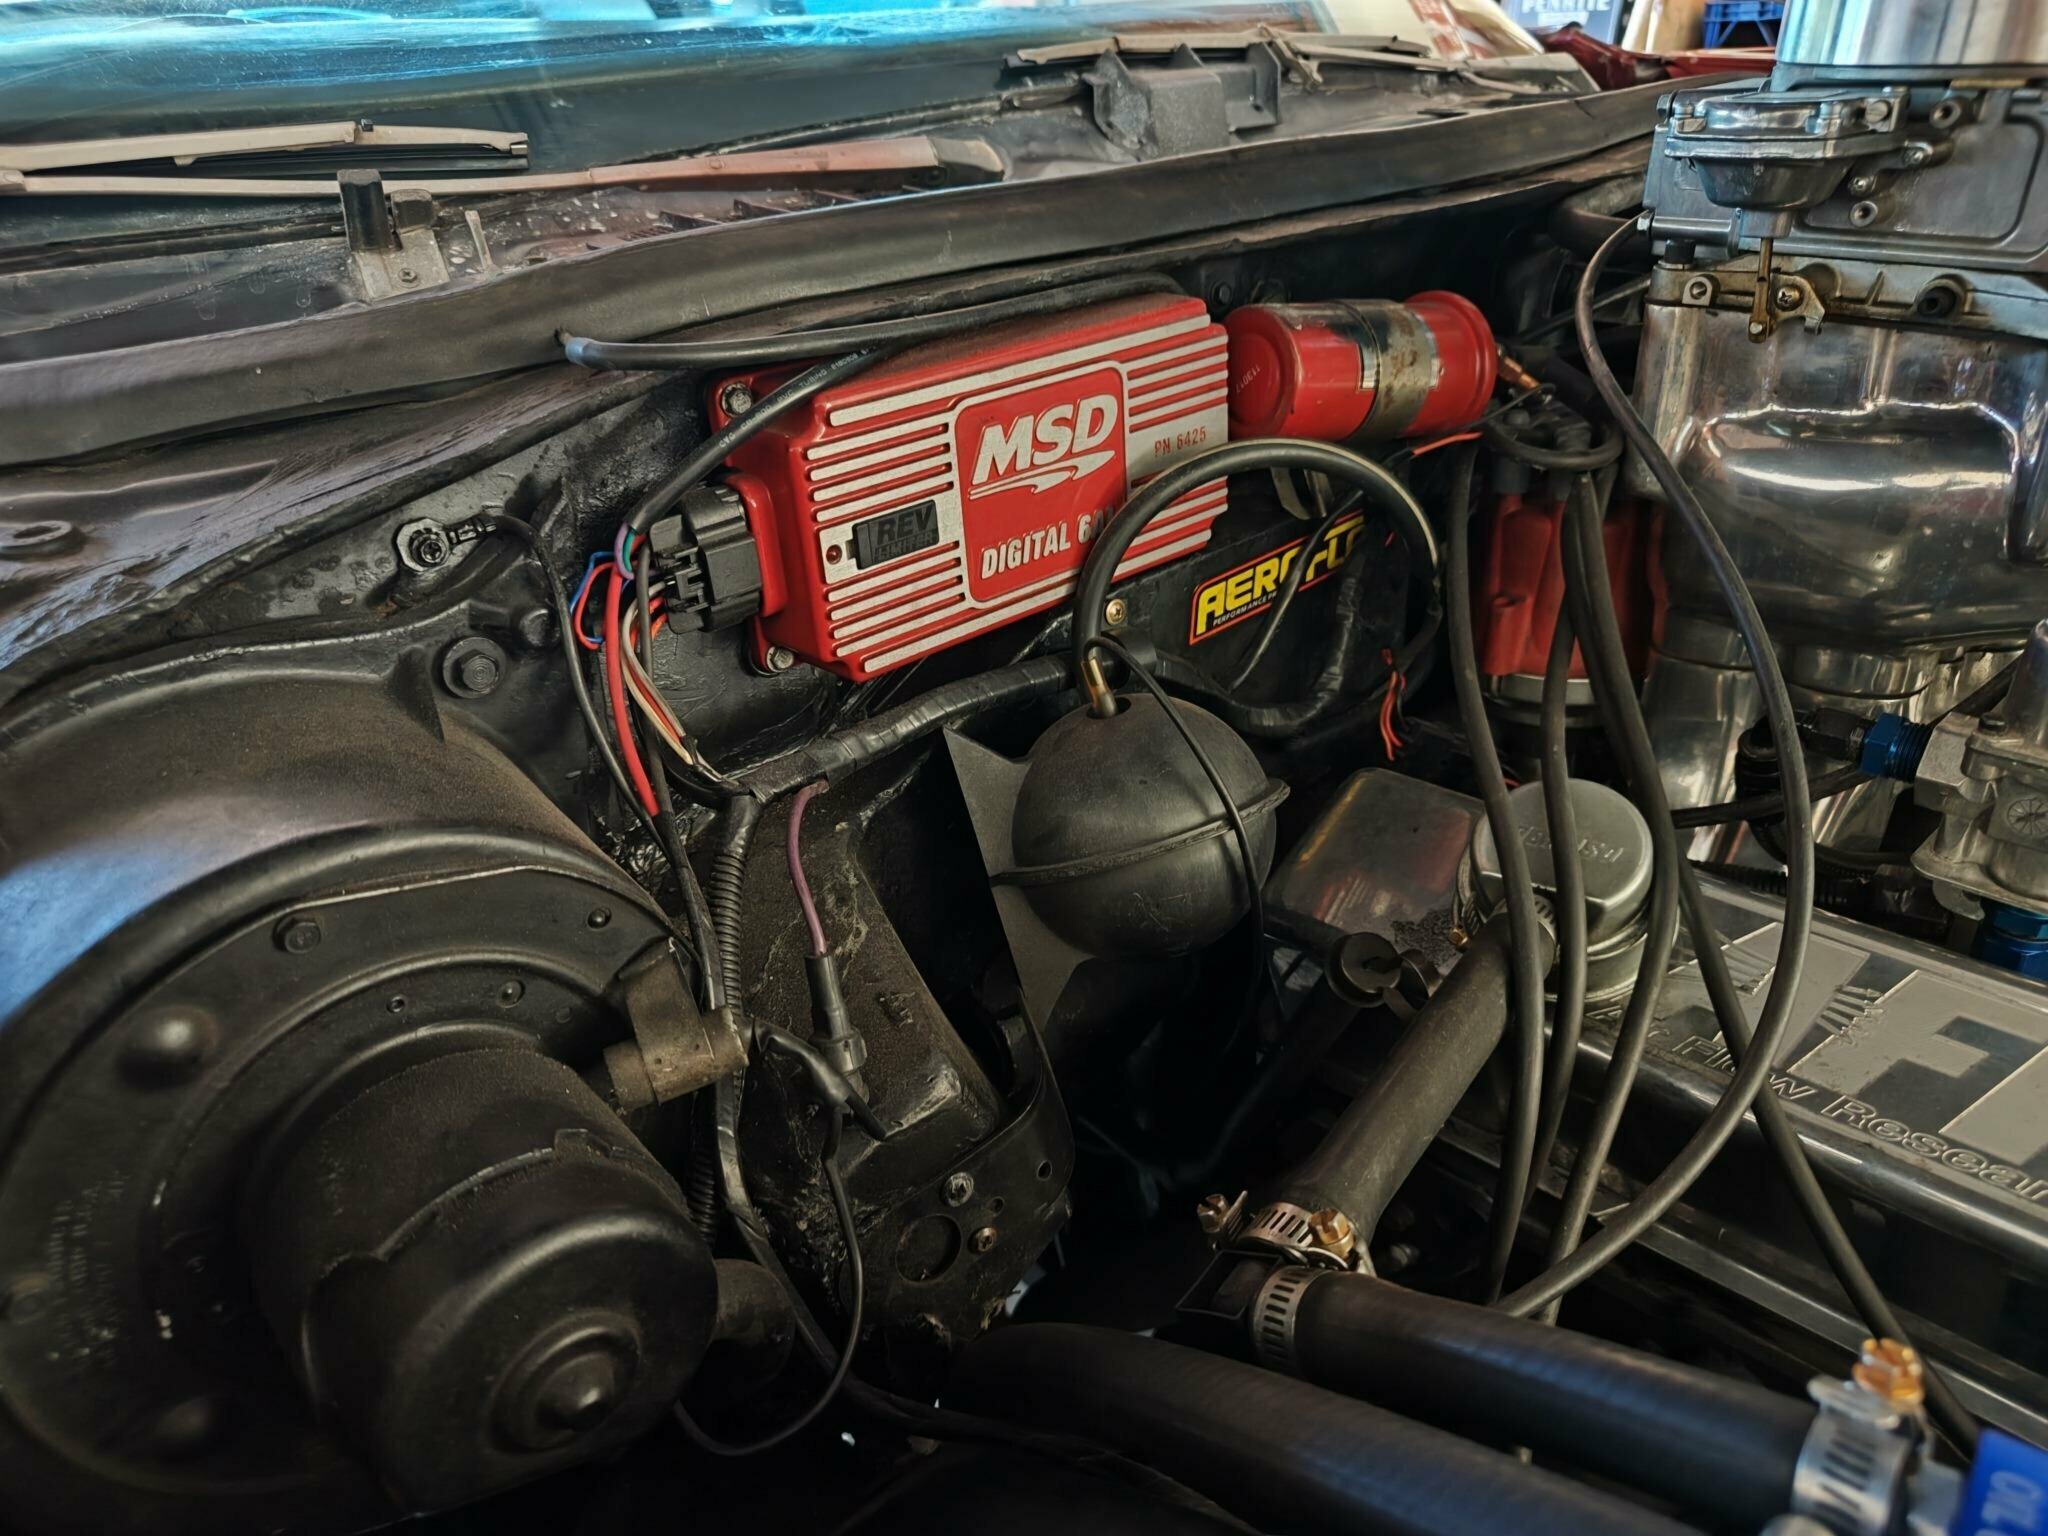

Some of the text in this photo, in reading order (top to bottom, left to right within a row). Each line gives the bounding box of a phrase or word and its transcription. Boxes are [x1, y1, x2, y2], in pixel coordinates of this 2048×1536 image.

[972, 394, 1118, 486] MSD
[1154, 427, 1207, 458] PN 6425
[877, 502, 934, 546] REV
[981, 522, 1071, 580] DIGITAL
[1212, 596, 1267, 627] PERFORMANCE
